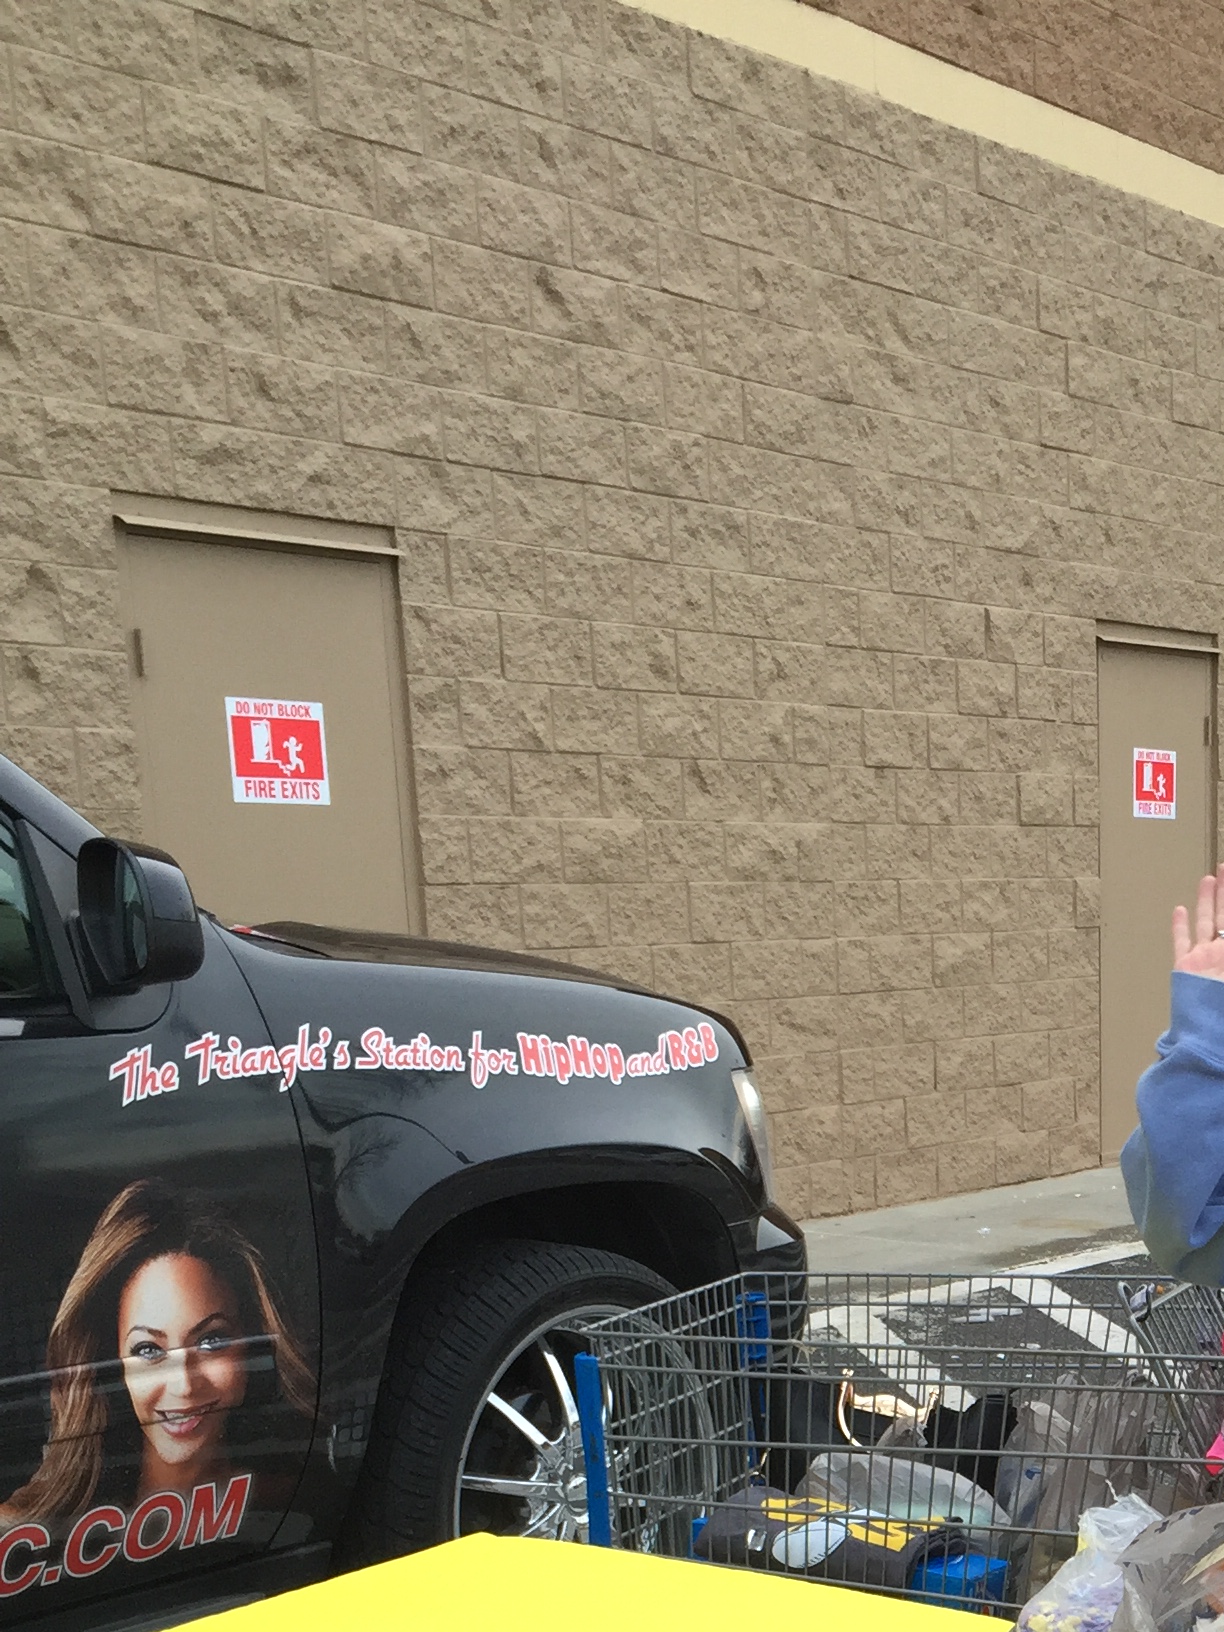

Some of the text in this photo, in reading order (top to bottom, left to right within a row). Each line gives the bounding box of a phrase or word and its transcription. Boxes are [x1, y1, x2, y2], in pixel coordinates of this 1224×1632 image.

[235, 701, 312, 718] DO NOT BLOCK
[244, 779, 321, 801] FIRE EXITS
[108, 1022, 719, 1107] The Triangle's Station for HipHop and R&B
